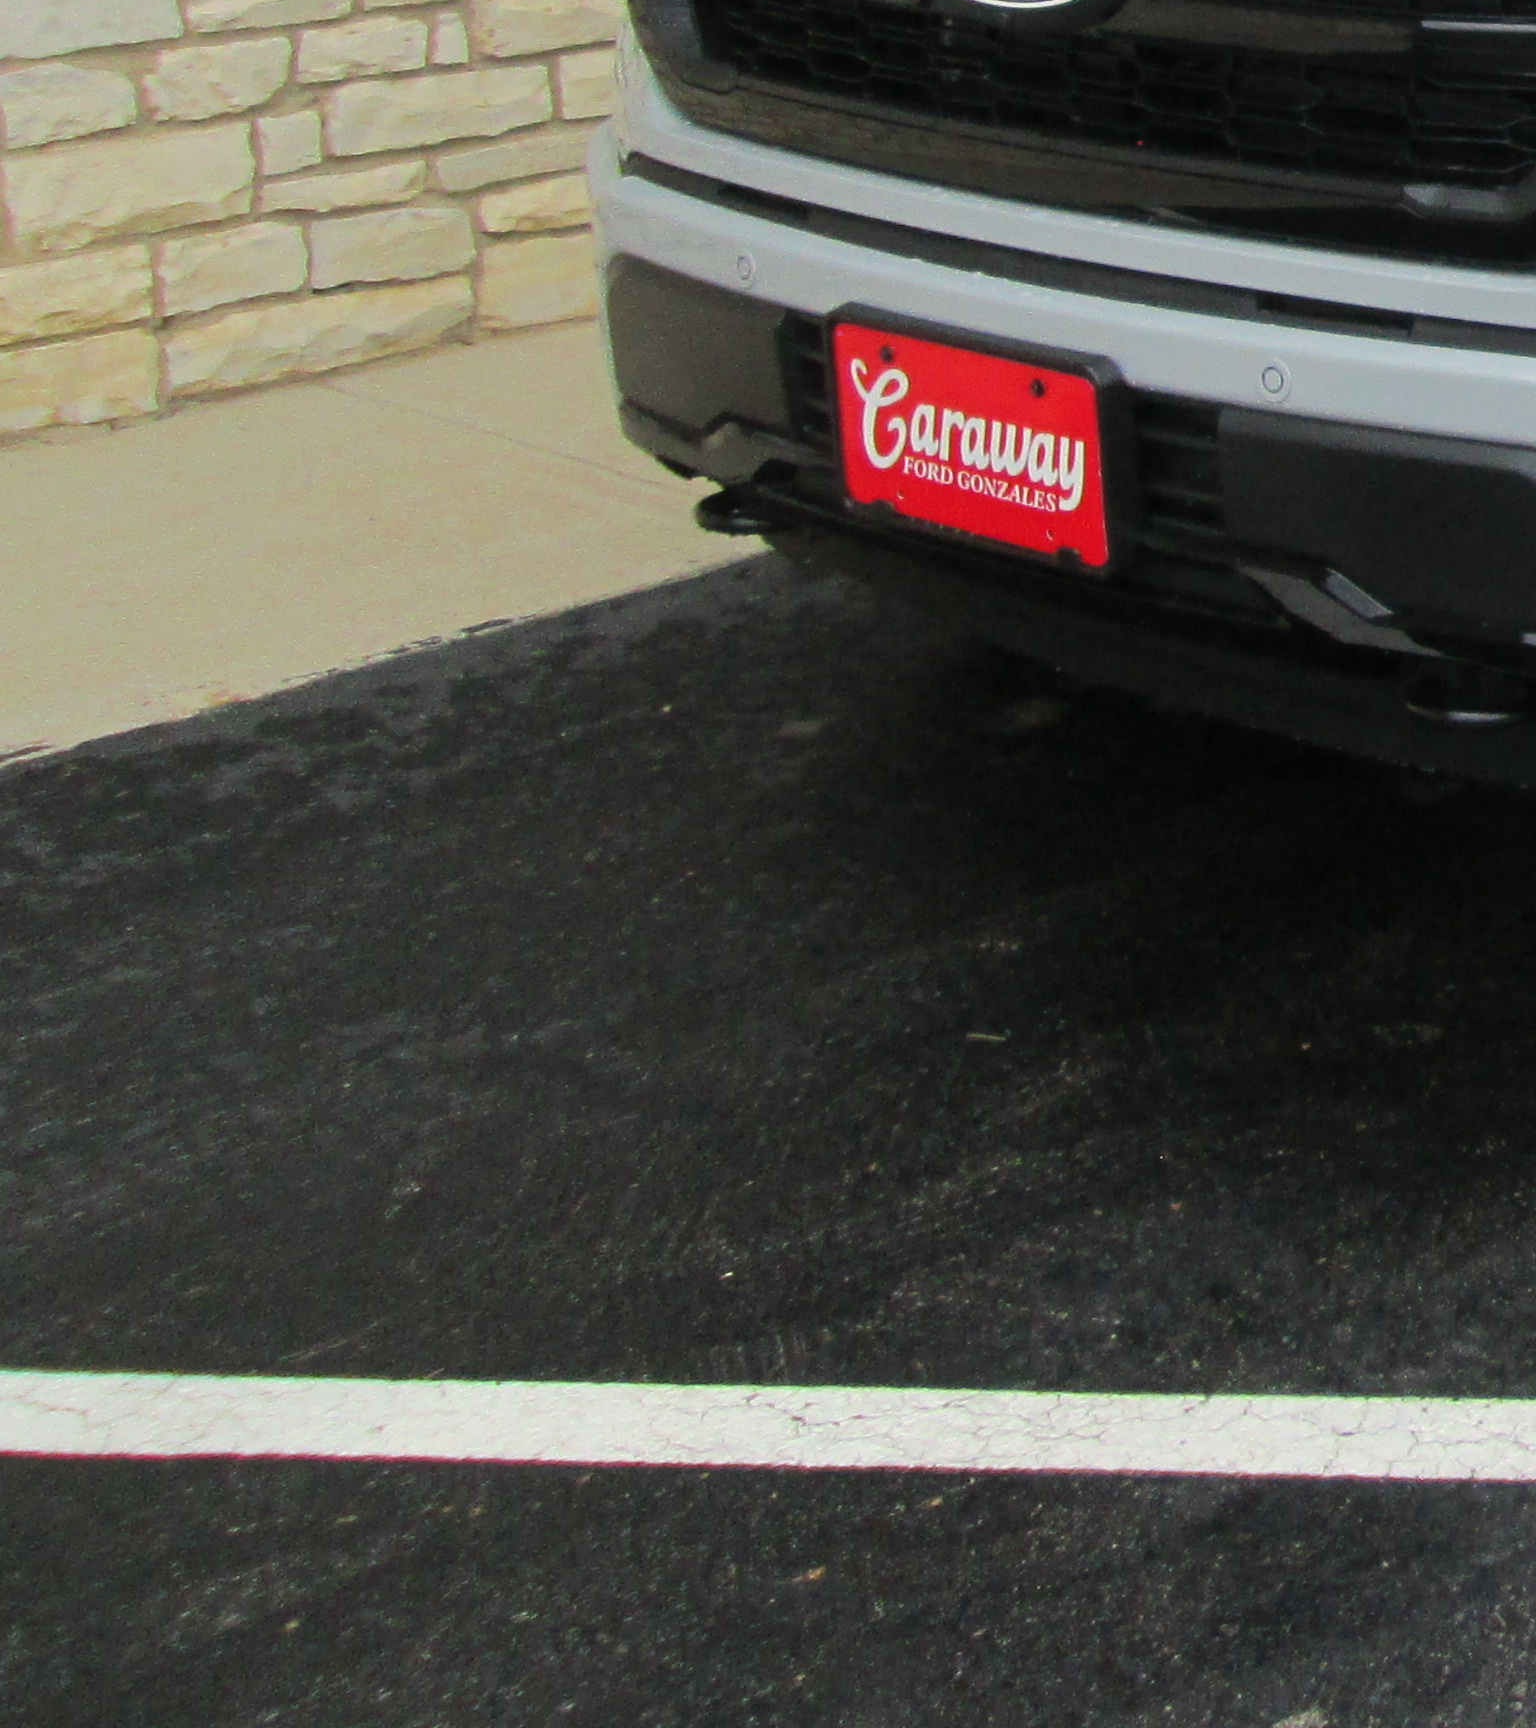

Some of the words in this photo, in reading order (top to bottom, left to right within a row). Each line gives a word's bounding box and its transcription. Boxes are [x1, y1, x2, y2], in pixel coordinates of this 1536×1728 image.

[851, 358, 1085, 512] Caraway
[903, 455, 954, 485] FORD
[957, 471, 1057, 513] GONZALES
